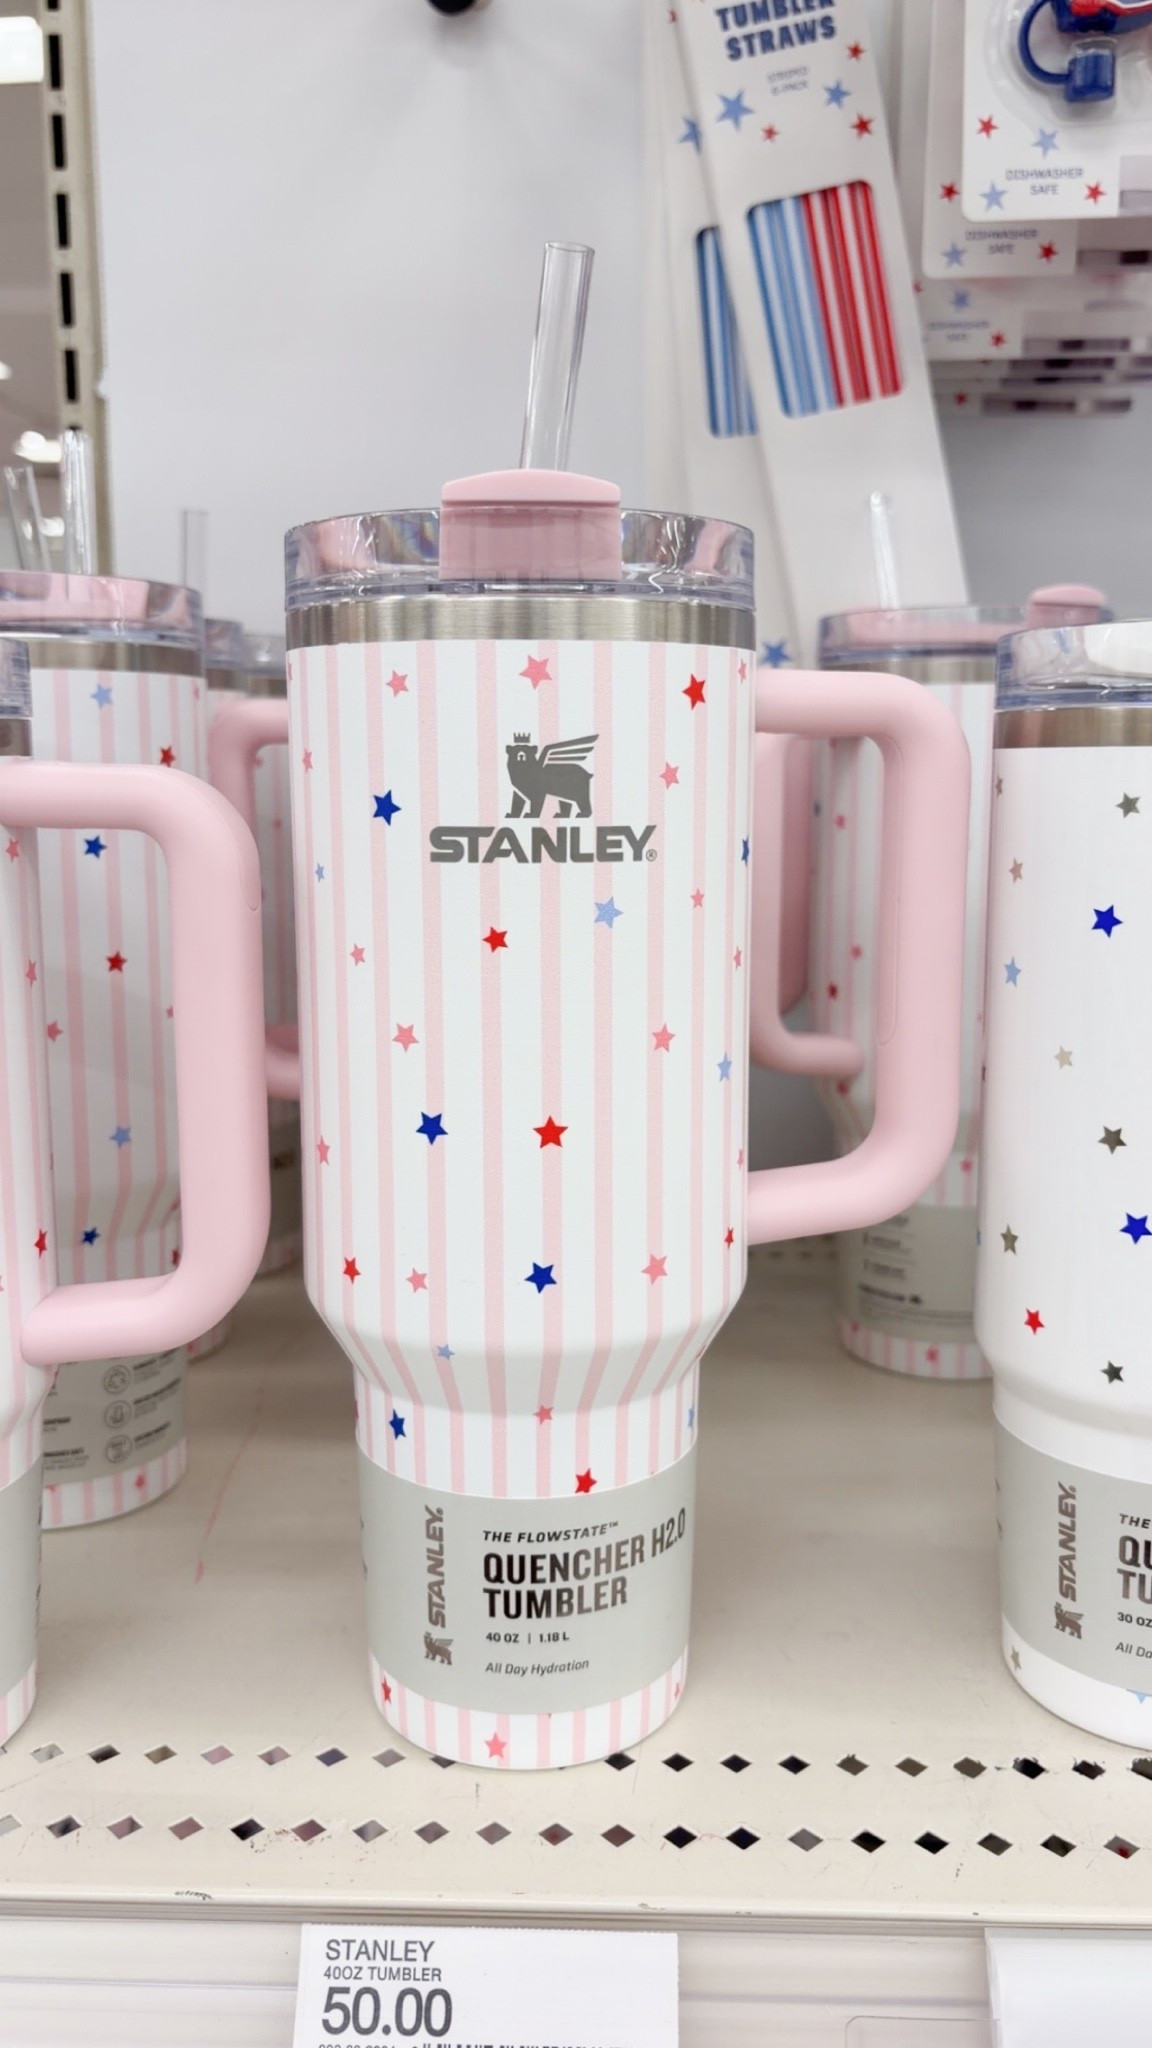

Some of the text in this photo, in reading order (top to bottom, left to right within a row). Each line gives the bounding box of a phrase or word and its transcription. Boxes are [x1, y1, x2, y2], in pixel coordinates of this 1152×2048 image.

[726, 15, 836, 61] STRAWS
[1006, 168, 1084, 181] DISHWASHER
[1030, 184, 1059, 195] SAFE
[1119, 1513, 1151, 1529] THE
[482, 1530, 512, 1543] THE
[483, 1534, 645, 1584] QUENCHER
[482, 1575, 627, 1619] TUMBLER
[1117, 1612, 1133, 1624] 30
[485, 1632, 501, 1643] 40
[504, 1633, 519, 1643] OZ
[539, 1632, 559, 1643] 1.18
[562, 1632, 570, 1641] L
[1115, 1641, 1133, 1655] All
[485, 1659, 589, 1677] All Day Hydration
[326, 1939, 435, 1962] STANLEY
[367, 1966, 442, 1982] TUMBLER
[322, 1986, 452, 2037] 50.00
